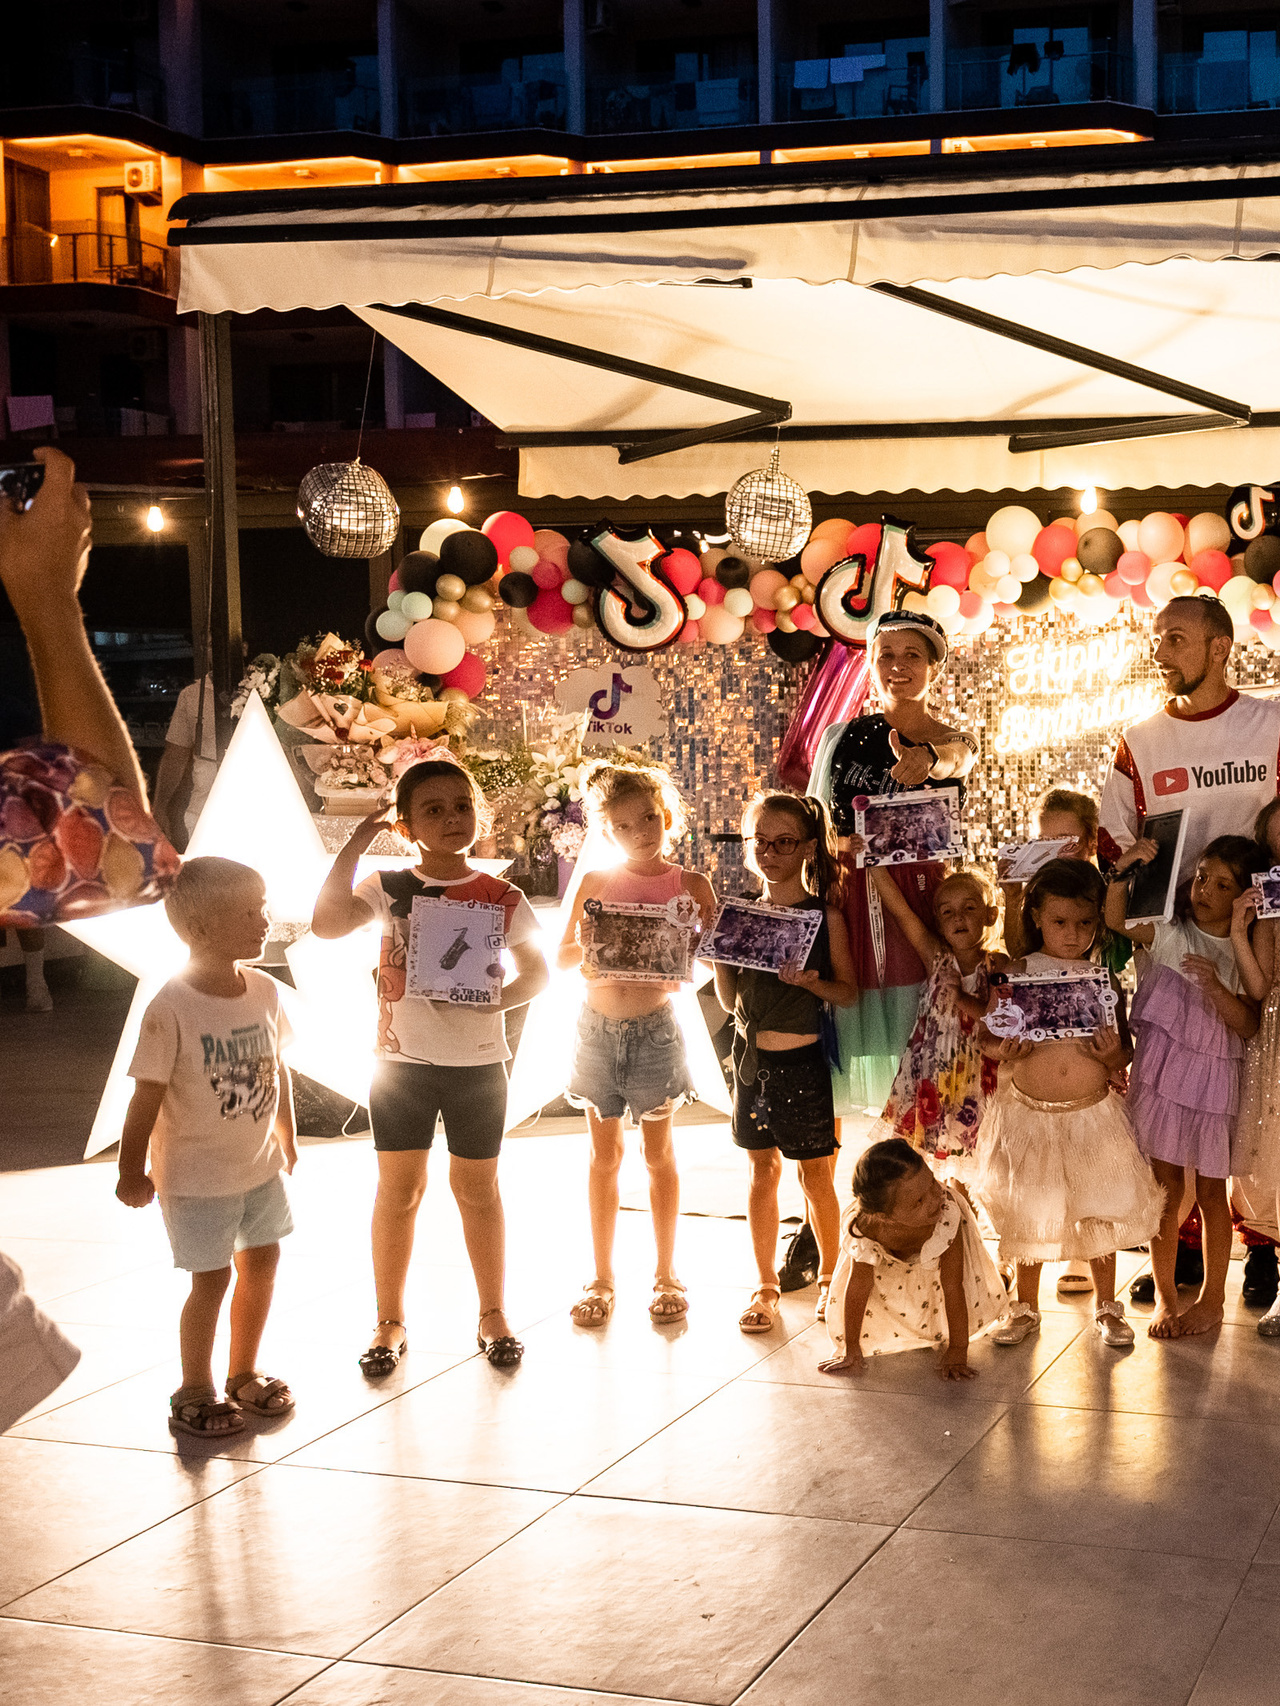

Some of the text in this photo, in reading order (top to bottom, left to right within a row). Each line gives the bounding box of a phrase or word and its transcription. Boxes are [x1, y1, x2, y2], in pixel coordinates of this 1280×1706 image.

[1006, 628, 1135, 695] Happy
[587, 720, 633, 735] TikTok
[1191, 760, 1267, 788] YouTube
[479, 902, 506, 913] TikTok
[449, 993, 491, 1003] QUEEN
[461, 987, 490, 997] TikTok
